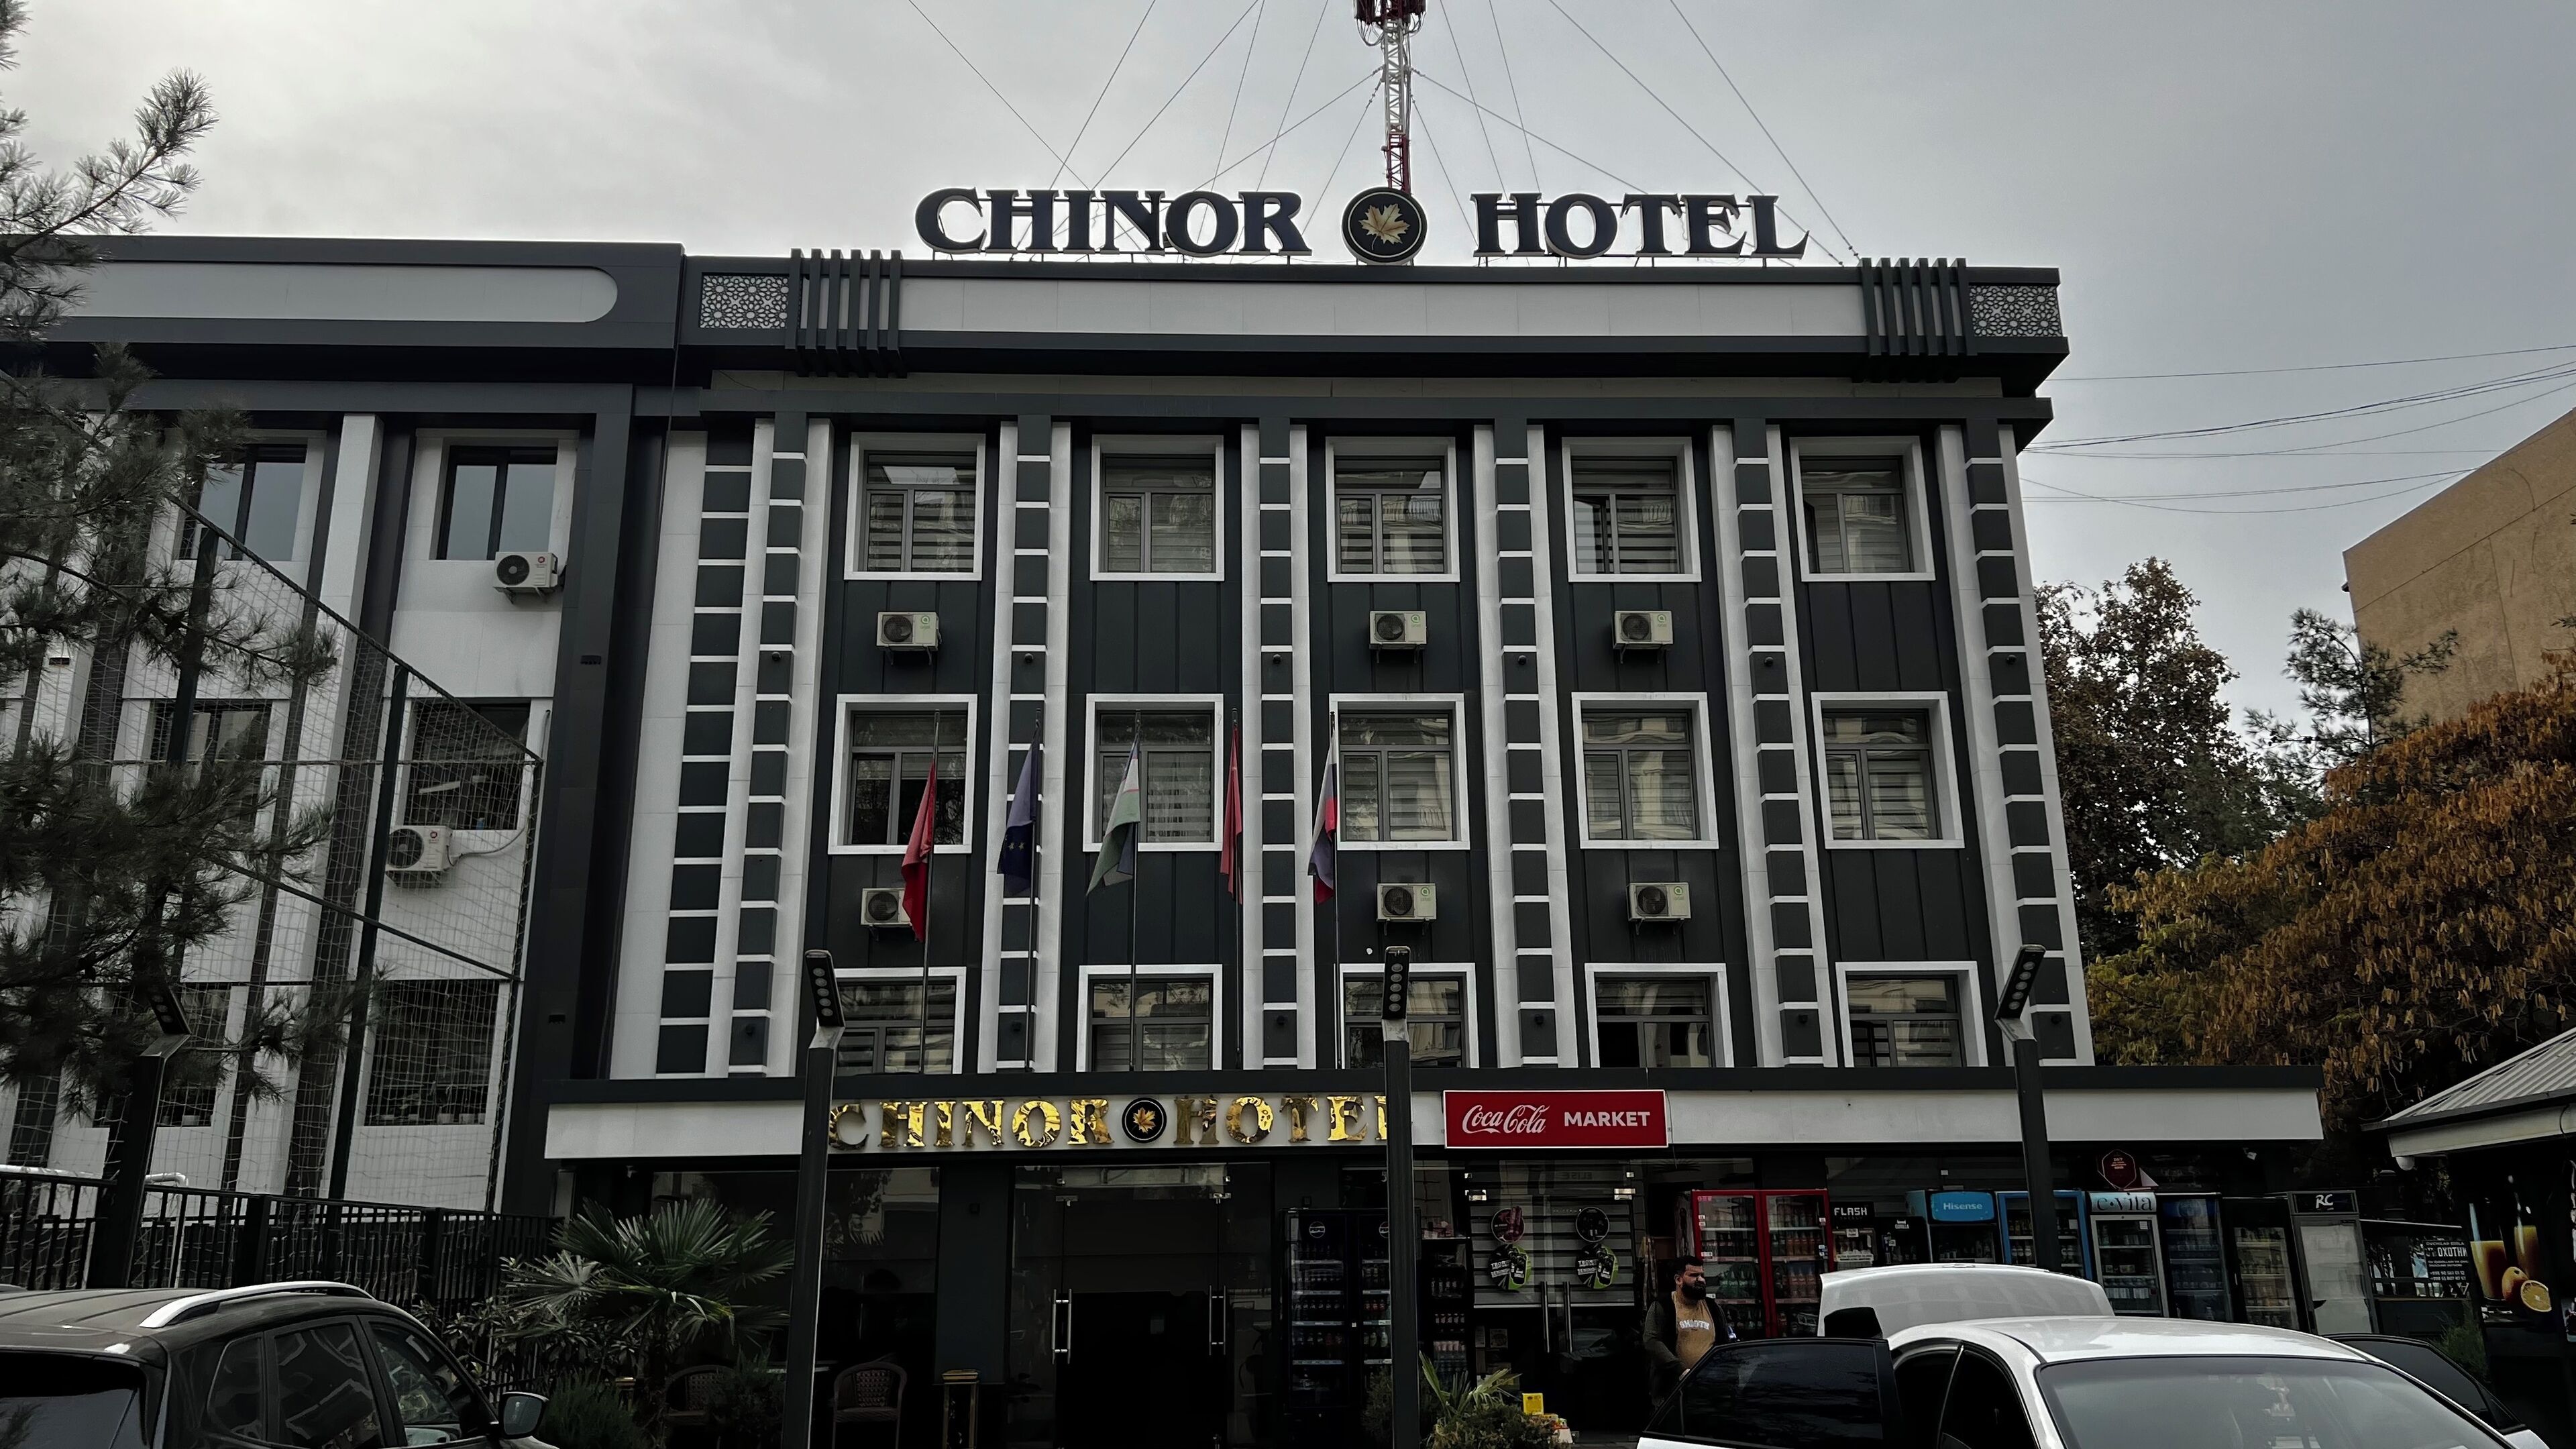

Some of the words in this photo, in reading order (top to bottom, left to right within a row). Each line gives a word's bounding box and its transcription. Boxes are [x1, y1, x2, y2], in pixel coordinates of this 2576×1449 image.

[915, 187, 1312, 257] CHINOR
[1470, 192, 1810, 260] HOTEL
[828, 1097, 1114, 1150] CHINOR
[1564, 1111, 1651, 1127] MARKET
[1943, 1200, 1983, 1212] Hisense
[2315, 1193, 2334, 1209] RC
[1833, 1207, 1868, 1216] FLASH
